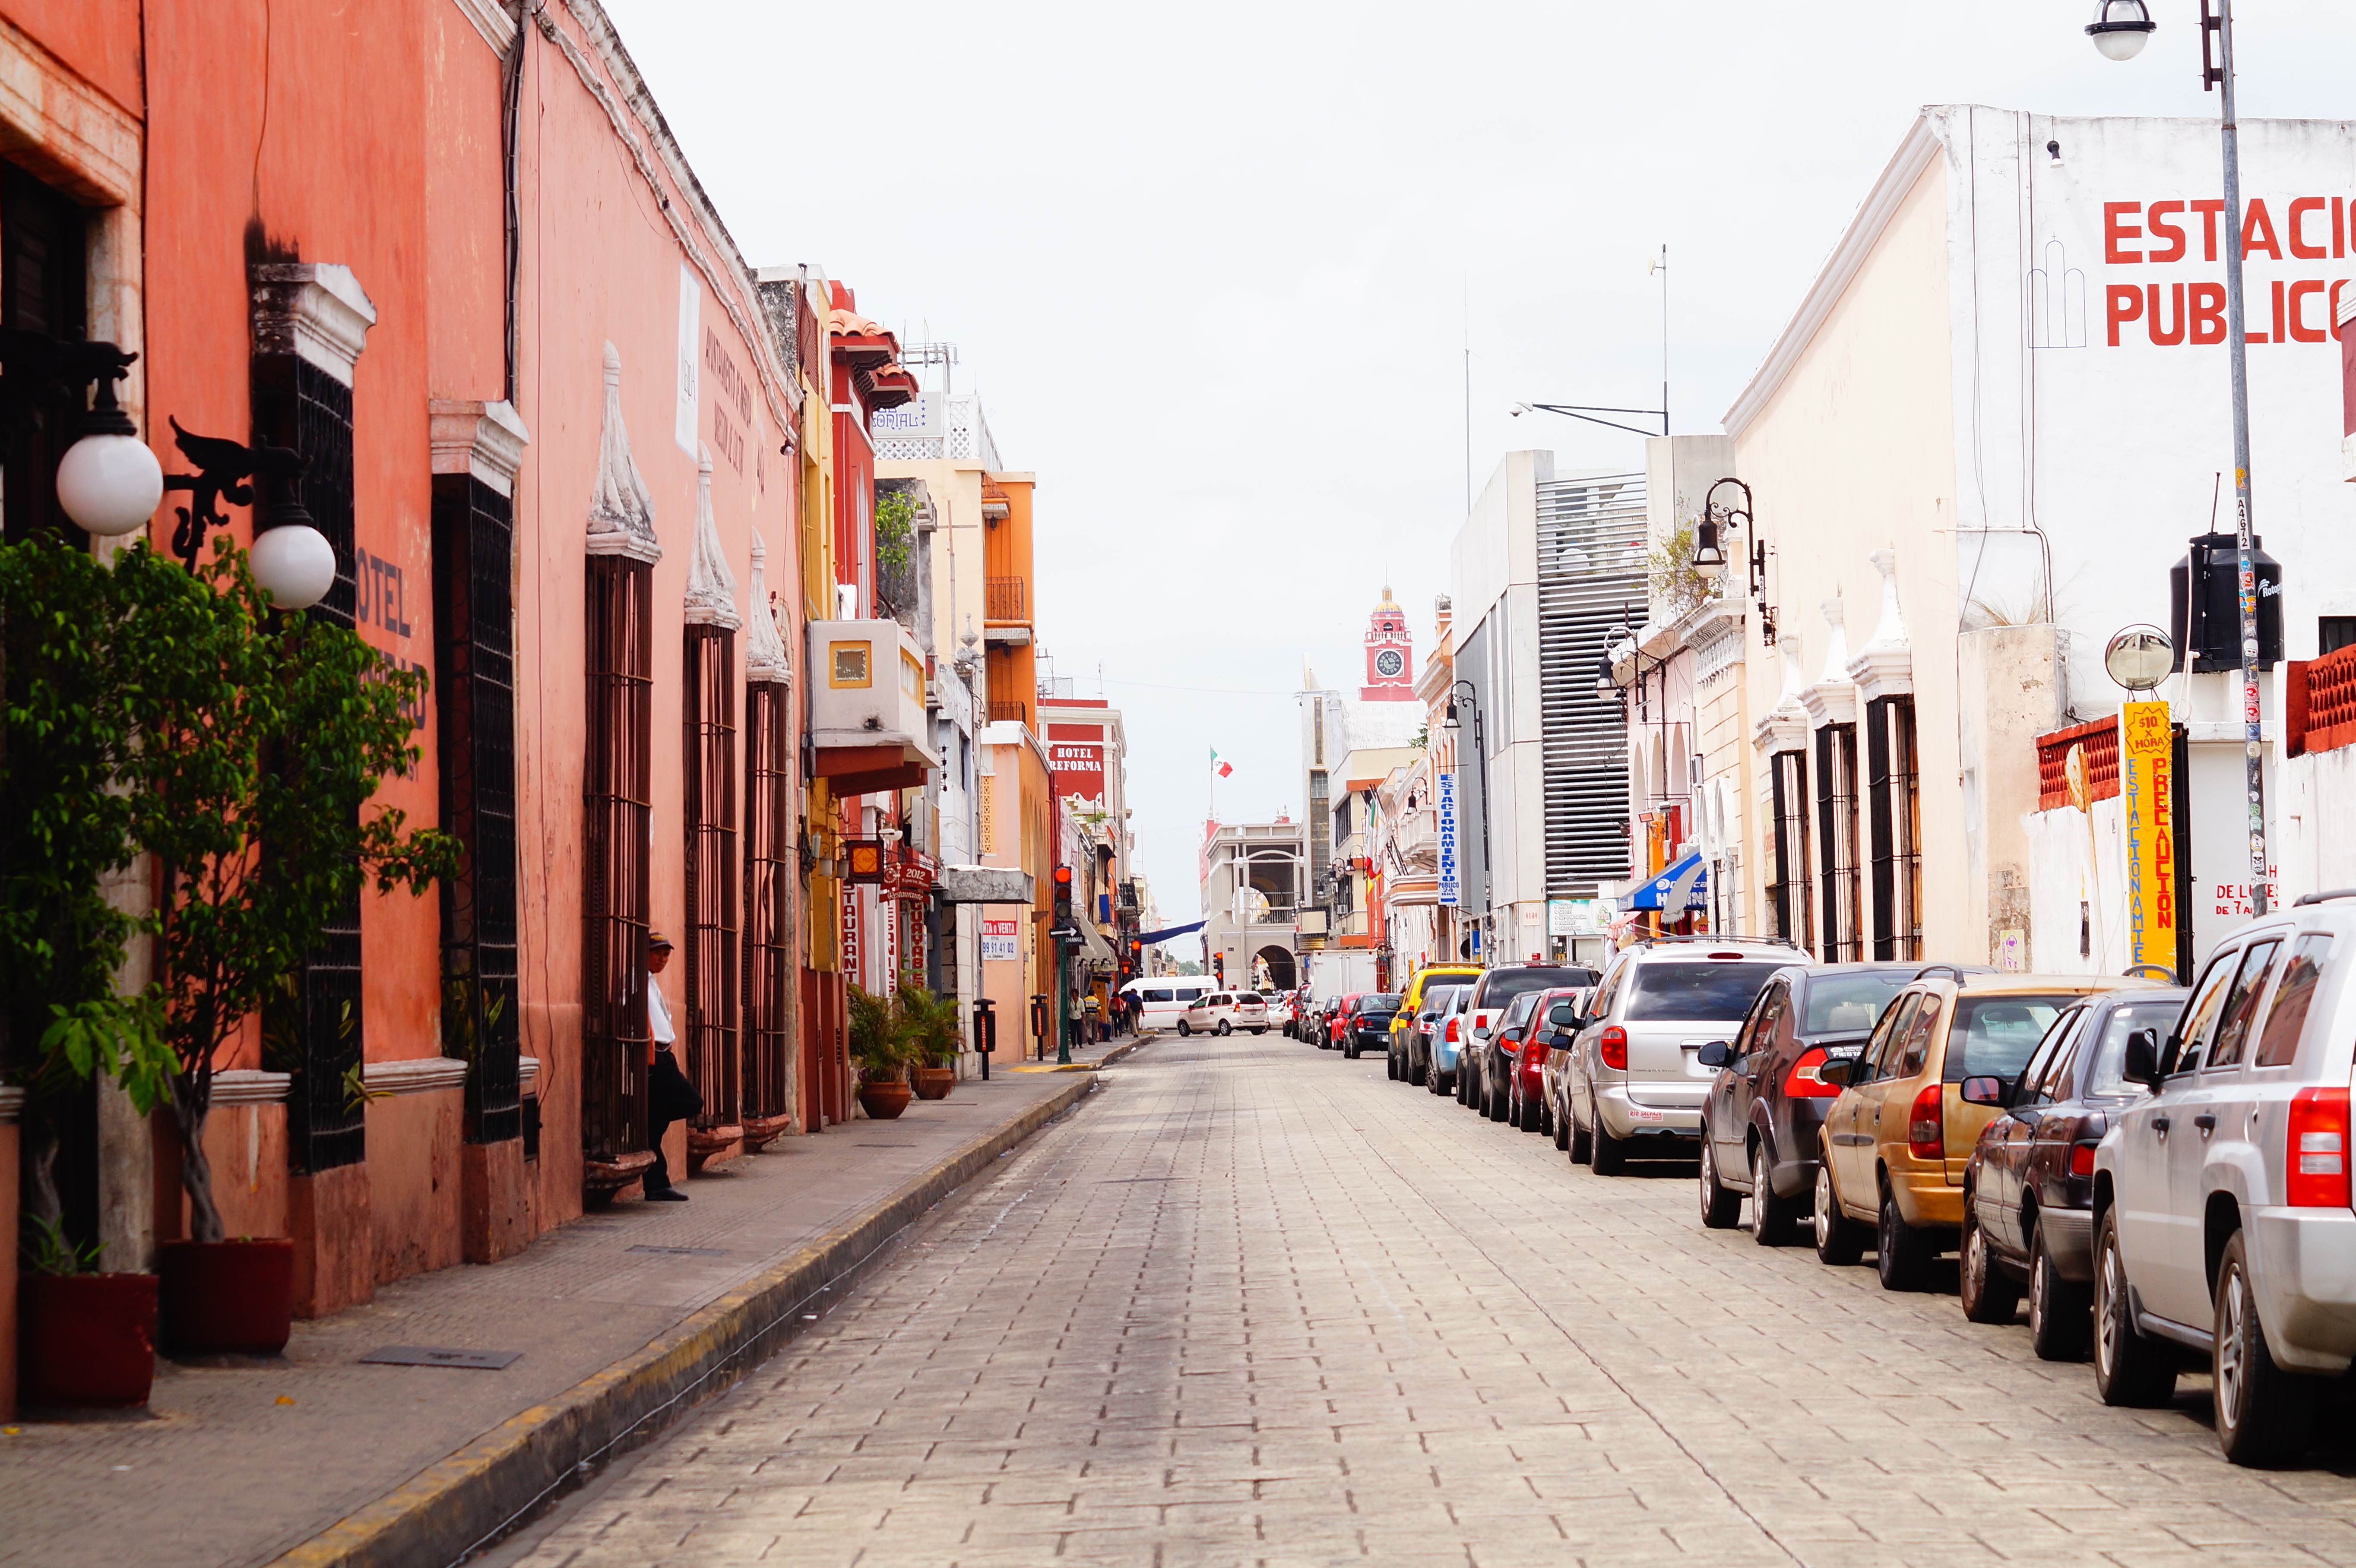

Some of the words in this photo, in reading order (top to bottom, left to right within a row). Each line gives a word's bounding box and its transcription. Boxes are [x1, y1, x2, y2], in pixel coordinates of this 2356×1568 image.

[2104, 196, 2356, 264] ESTACI
[2238, 499, 2248, 547] A4672
[356, 547, 411, 638] OTEL
[2139, 716, 2159, 728] $10
[2135, 737, 2164, 749] HORA
[1057, 748, 1093, 758] HOTEL
[1049, 760, 1102, 771] REFORMA
[1441, 774, 1455, 882] ESTACIONAMIENTO
[2152, 758, 2172, 929] PRECAUCION
[906, 868, 925, 880] 2012
[887, 891, 924, 901] Restaurante
[2217, 885, 2234, 898] DE
[2216, 905, 2229, 915] DE
[2233, 901, 2241, 914] 7
[998, 922, 1015, 934] VENTA
[991, 942, 997, 953] 91
[999, 942, 1005, 953] 41
[1007, 942, 1014, 953] 02
